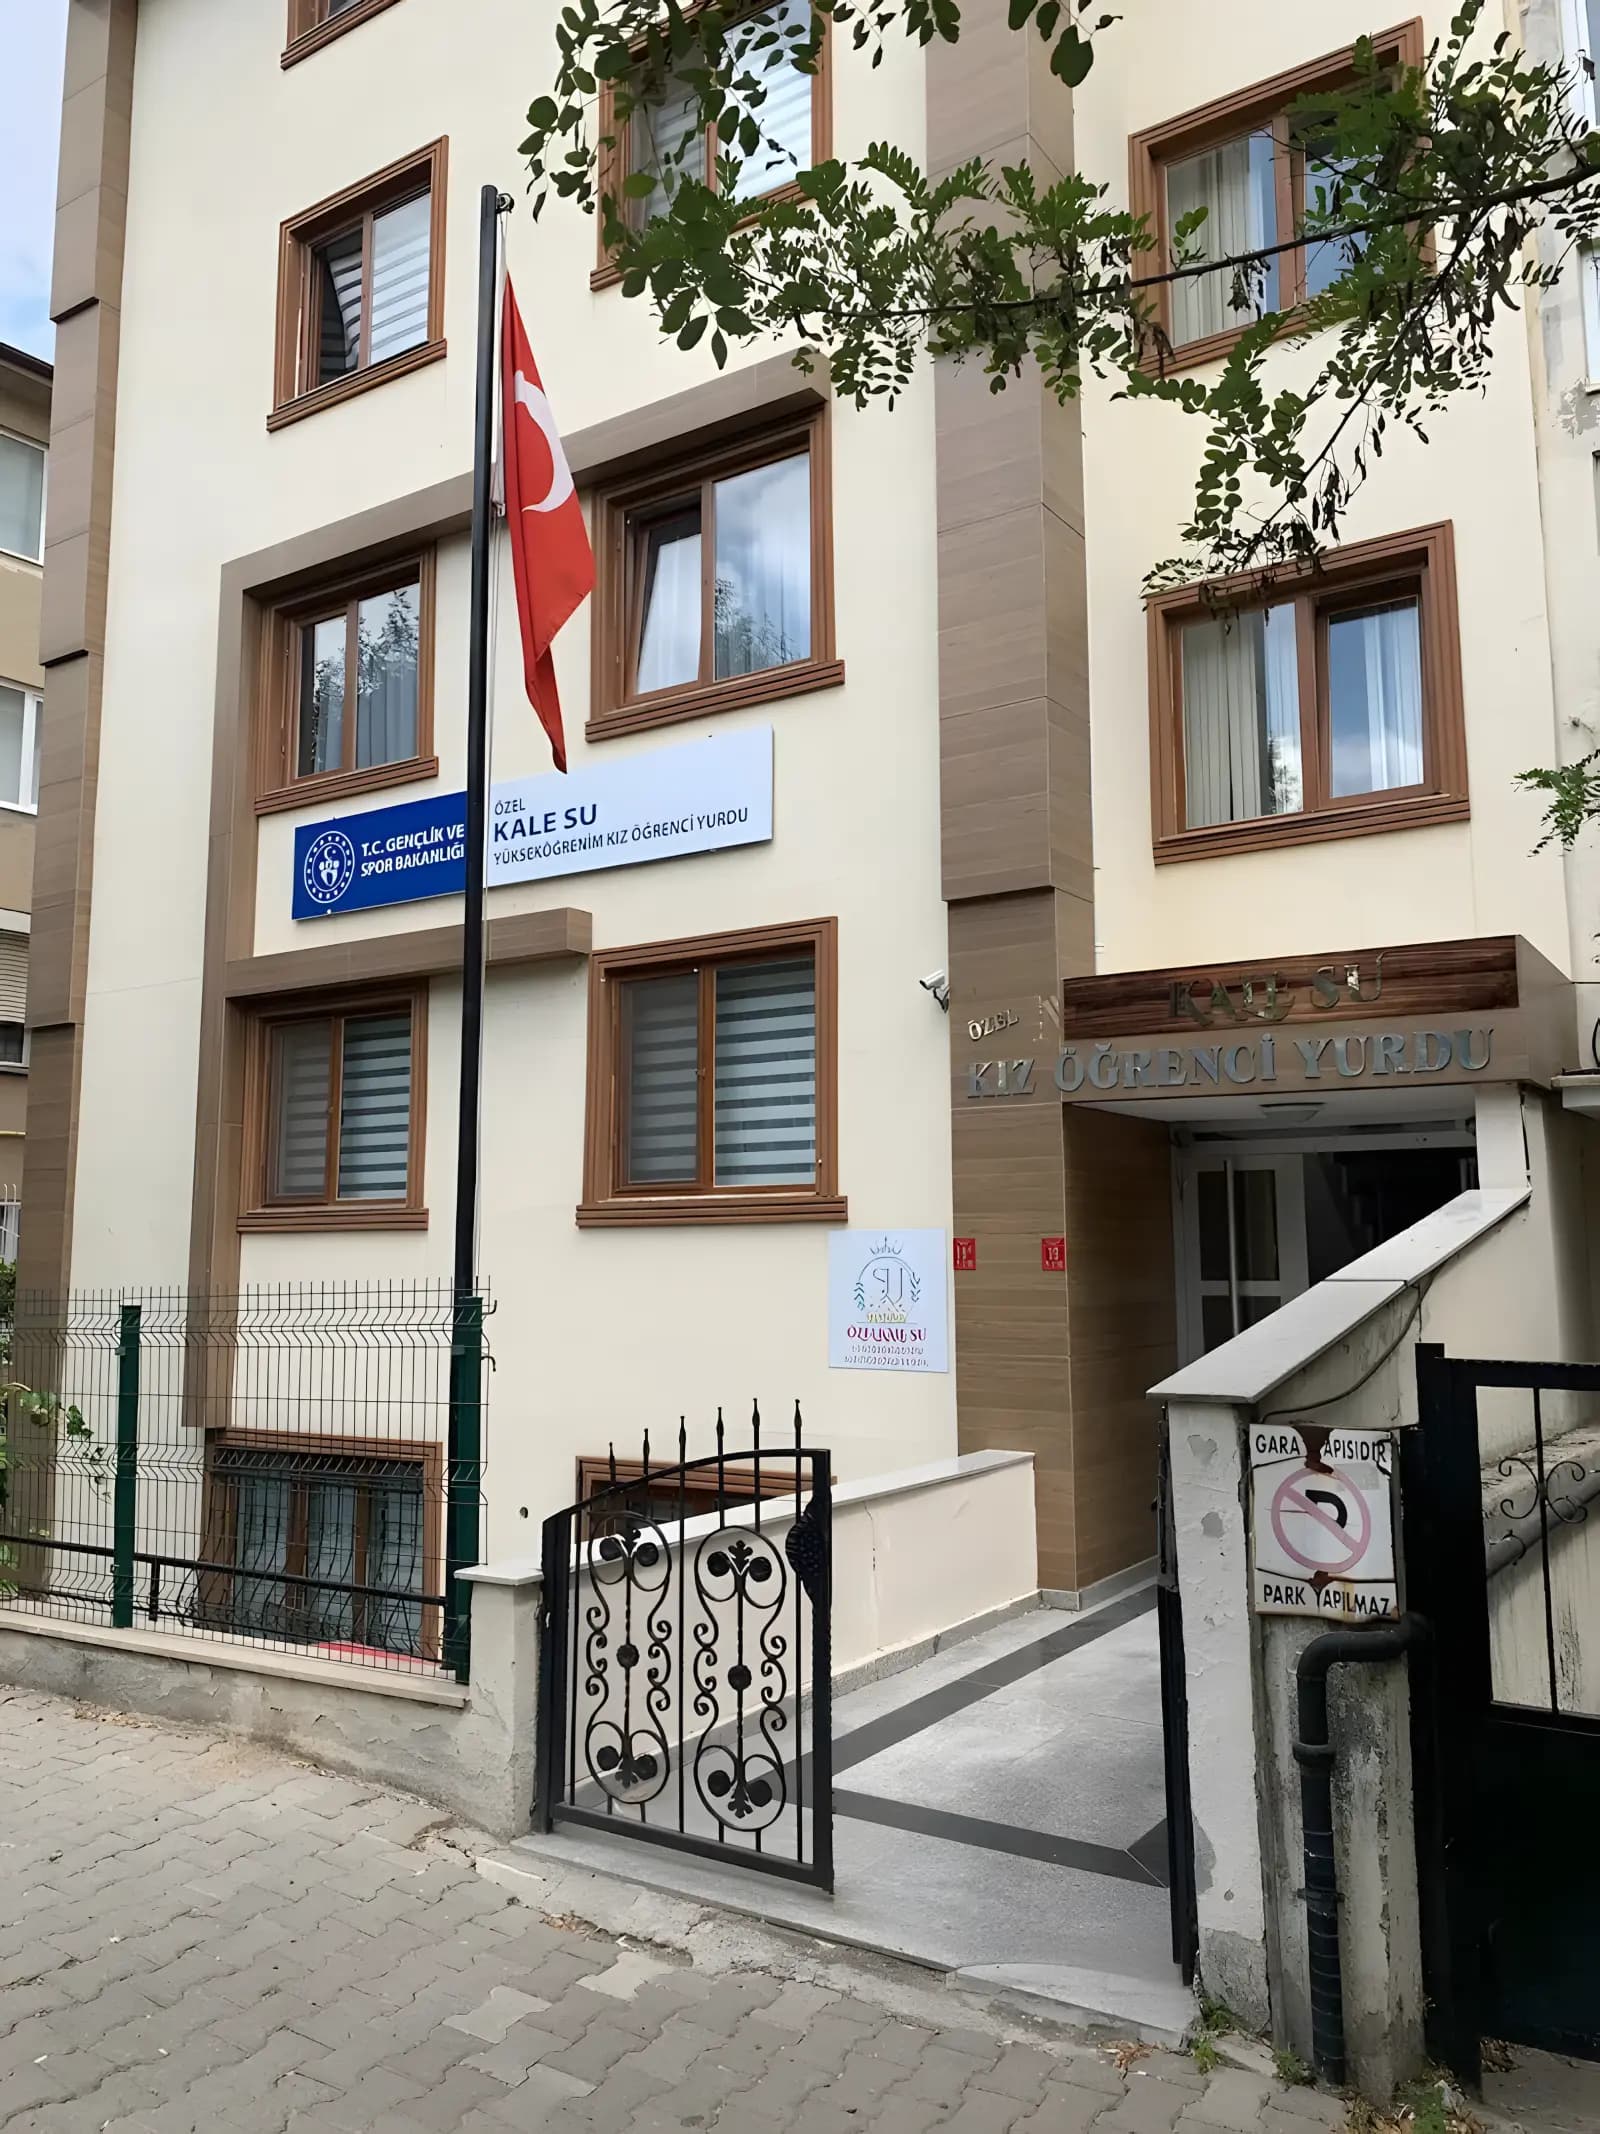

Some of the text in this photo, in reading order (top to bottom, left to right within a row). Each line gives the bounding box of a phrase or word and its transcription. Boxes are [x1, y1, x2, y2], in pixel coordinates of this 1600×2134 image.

[494, 798, 526, 816] ÖZEL
[494, 803, 598, 843] KALE SU
[361, 823, 465, 857] T.C. GENÇLİK VE
[493, 806, 749, 866] YÜKSEKÖĞRENİM KIZ ÖĞRENCİ YURDU
[360, 841, 465, 877] SPOR BAKANLIĞI
[967, 1027, 1495, 1099] KIZ ÖĞRENCİ YURDU
[1255, 1433, 1387, 1464] GARA APISIDIR
[1263, 1583, 1392, 1617] PARK YAPILMAZ
